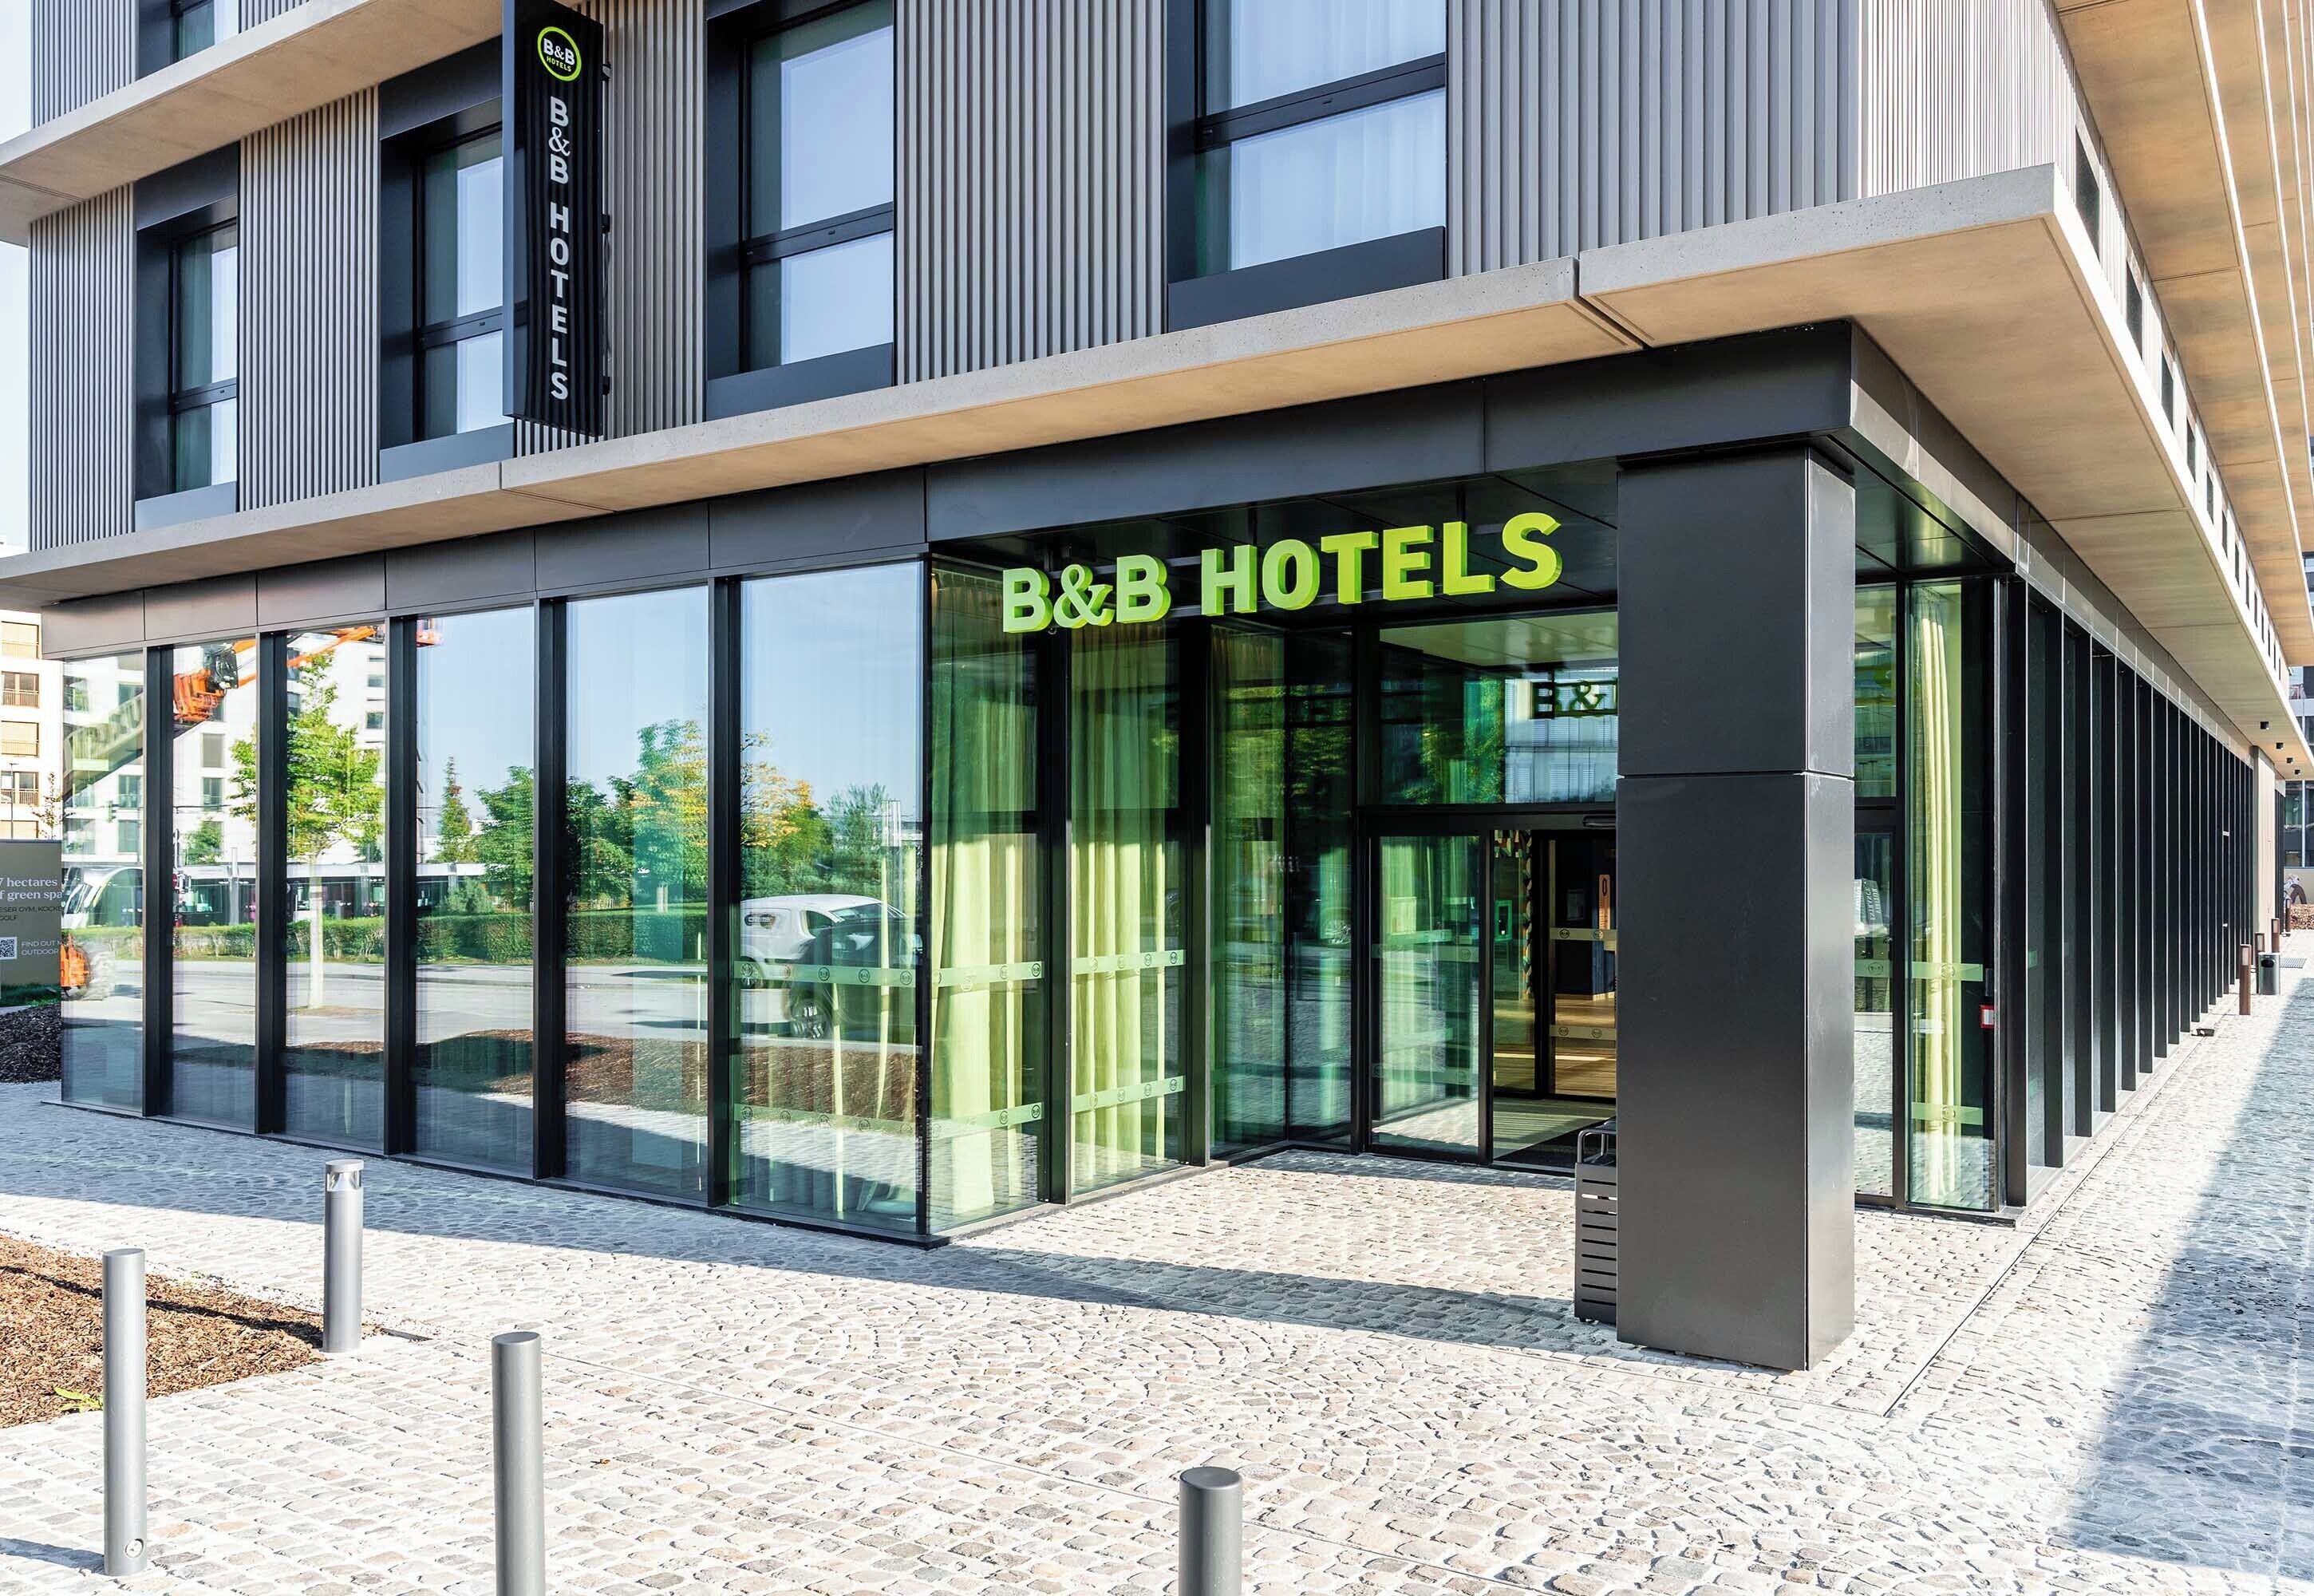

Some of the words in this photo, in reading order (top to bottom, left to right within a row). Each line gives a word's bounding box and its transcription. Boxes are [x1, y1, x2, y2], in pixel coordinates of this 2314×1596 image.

[543, 38, 575, 65] B&B
[546, 56, 571, 72] HOTELS
[548, 96, 571, 184] B&B
[549, 201, 569, 401] HOTELS
[1002, 554, 1171, 634] B&B
[1200, 512, 1563, 616] HOTELS
[6, 878, 58, 887] hectares
[7, 891, 41, 902] green
